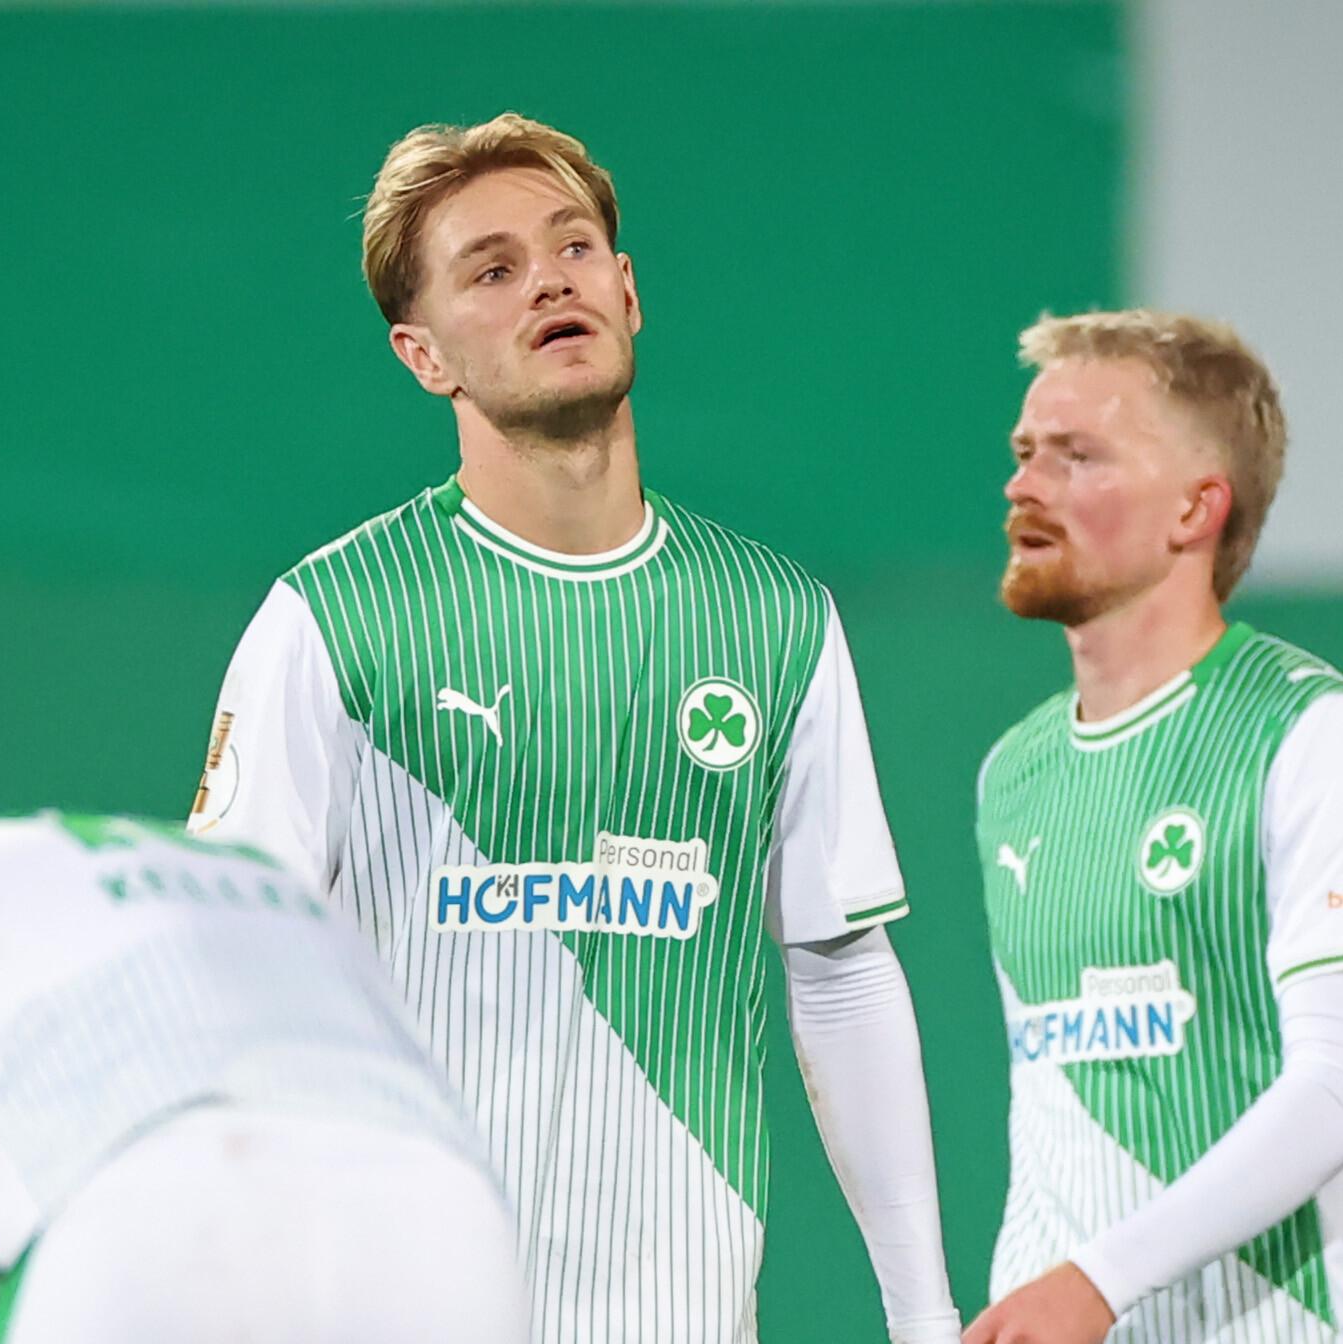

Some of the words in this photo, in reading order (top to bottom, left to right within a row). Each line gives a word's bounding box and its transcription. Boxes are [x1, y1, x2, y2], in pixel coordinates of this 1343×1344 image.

[598, 838, 699, 873] Personal
[437, 873, 694, 931] HOFMANN
[1087, 969, 1172, 995] Personal
